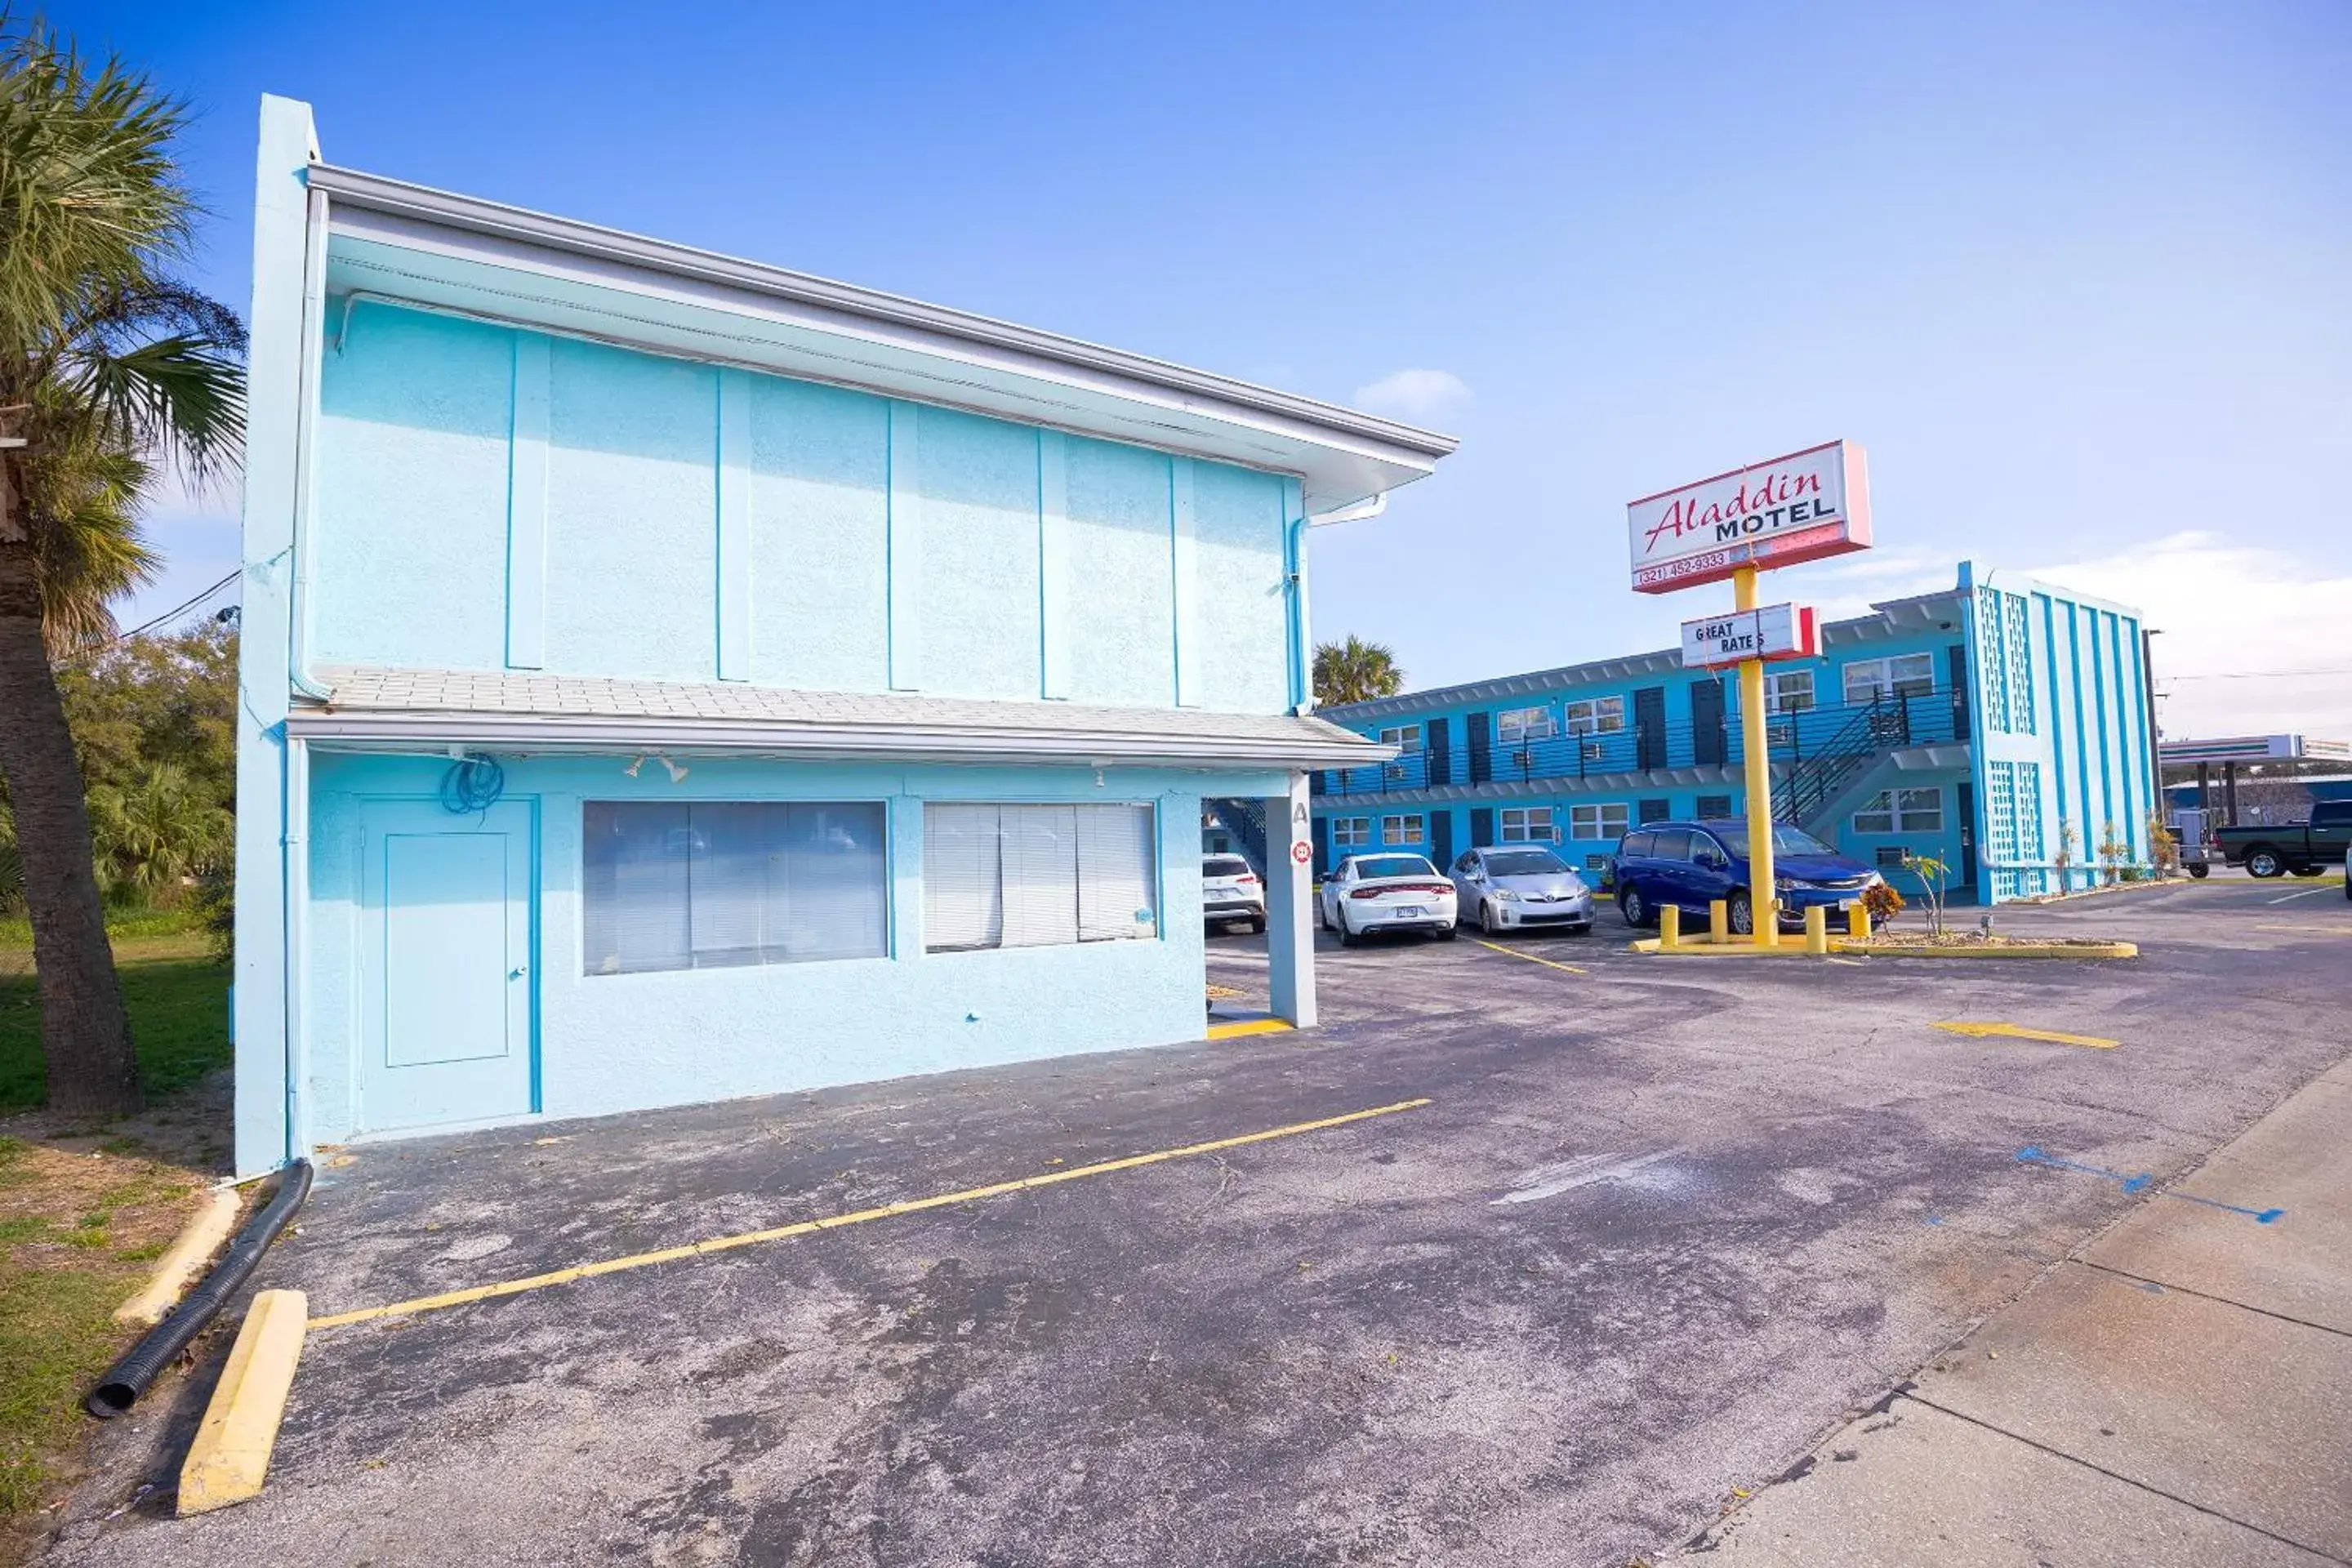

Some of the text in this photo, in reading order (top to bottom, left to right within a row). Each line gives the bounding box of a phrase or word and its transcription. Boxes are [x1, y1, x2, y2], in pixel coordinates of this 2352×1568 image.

[1645, 471, 1821, 553] Aladdin
[1715, 498, 1835, 542] MOTEL
[1670, 552, 1725, 577] 452-9333
[1695, 622, 1734, 641] GREAT
